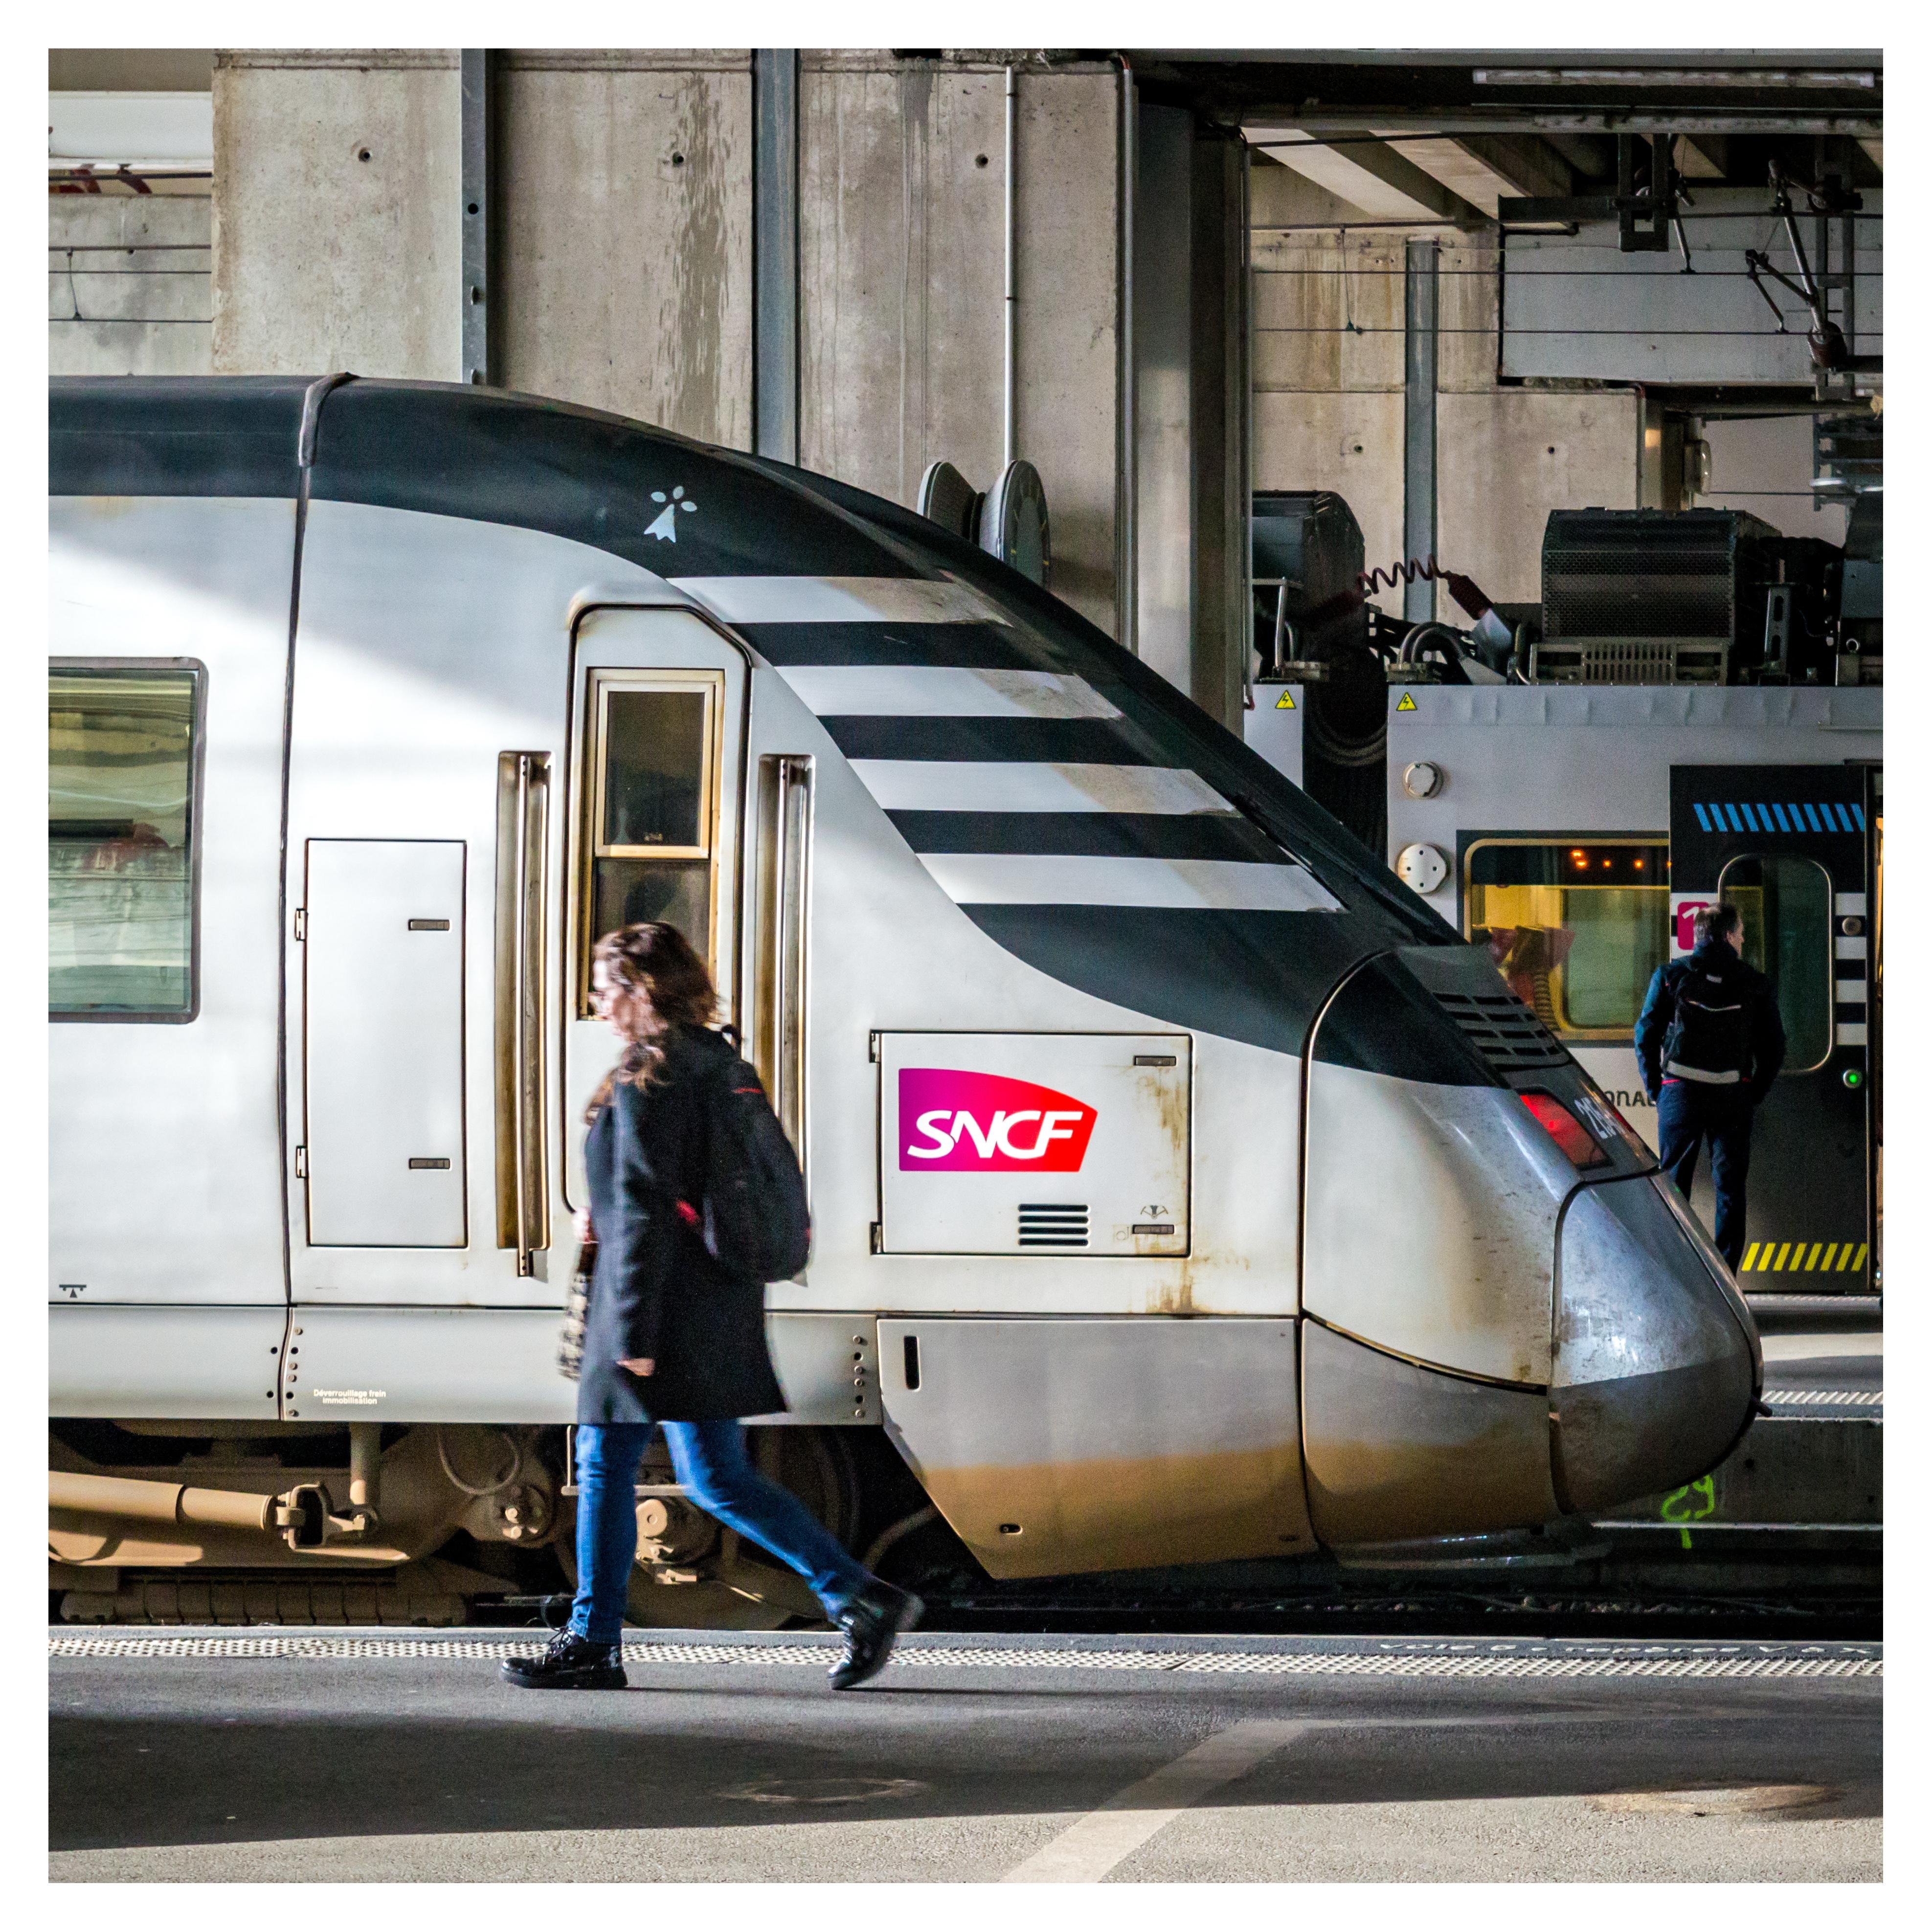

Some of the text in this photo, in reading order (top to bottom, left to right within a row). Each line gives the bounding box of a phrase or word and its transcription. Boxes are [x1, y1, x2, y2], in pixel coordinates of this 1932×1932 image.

[906, 1109, 1083, 1160] SNCF
[313, 1388, 386, 1398] Déverrouillage frein
